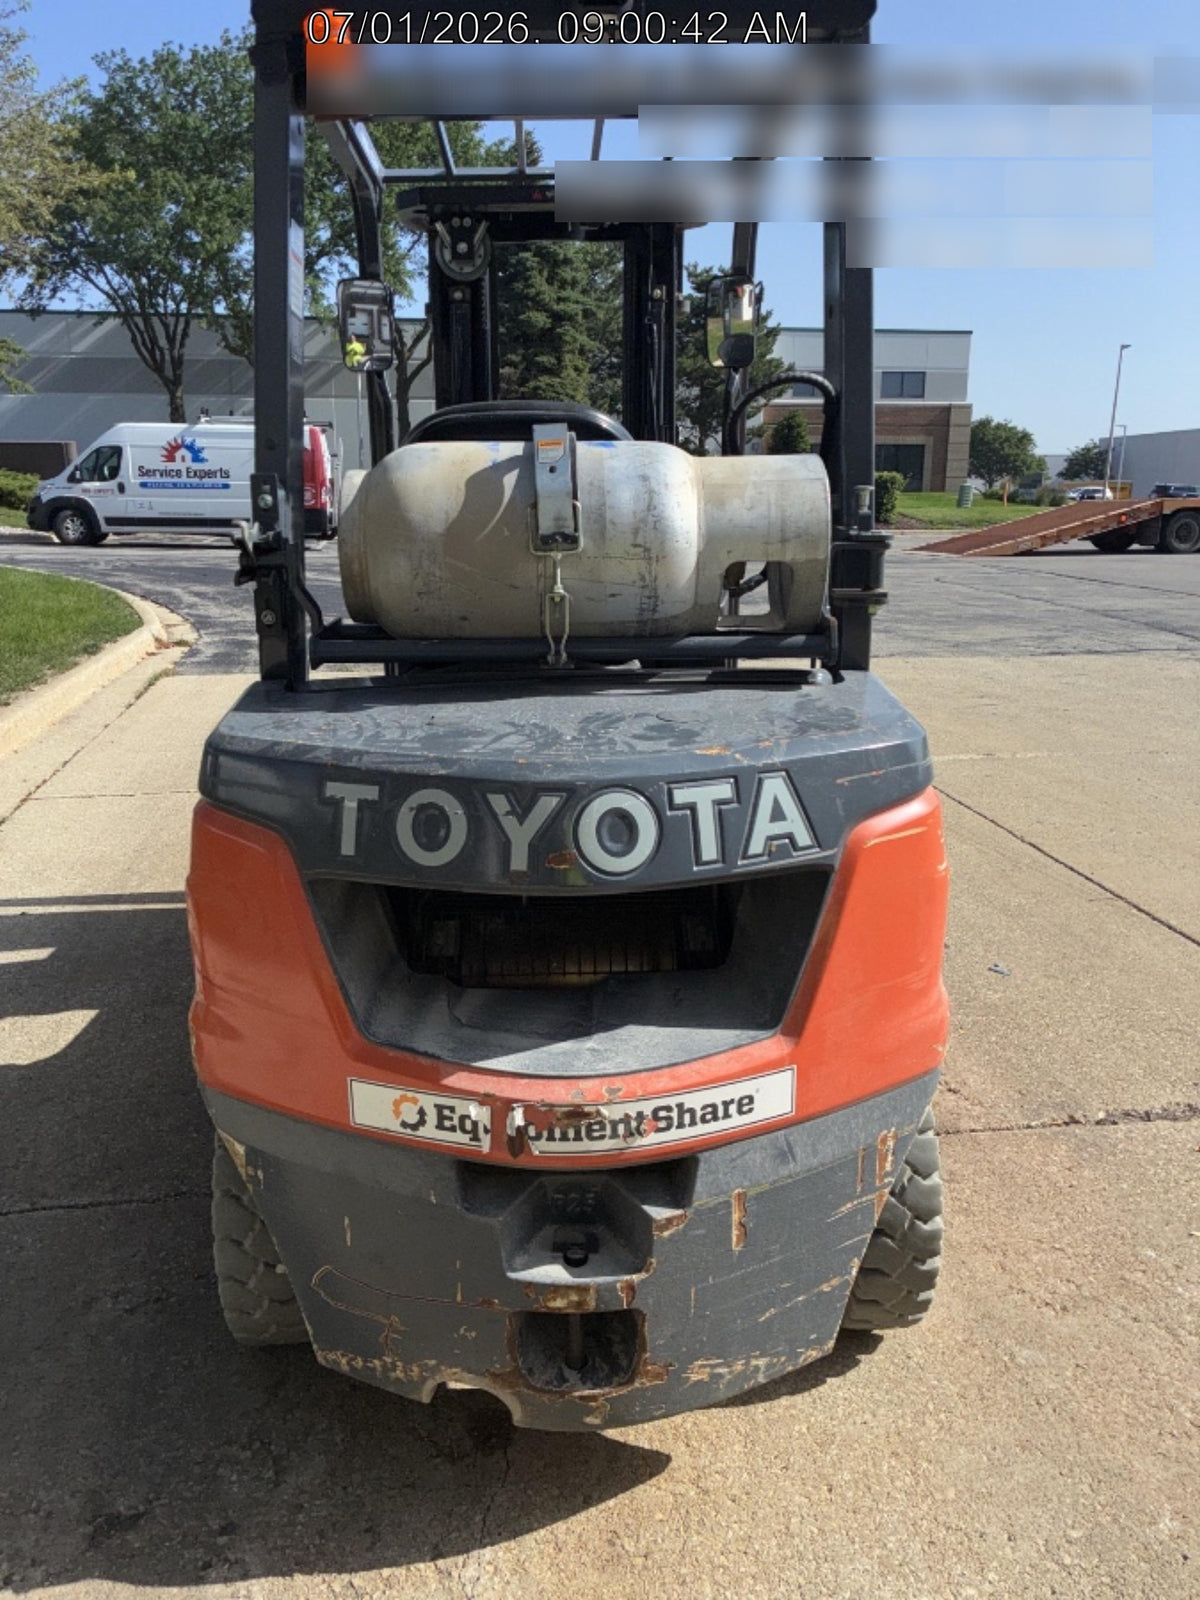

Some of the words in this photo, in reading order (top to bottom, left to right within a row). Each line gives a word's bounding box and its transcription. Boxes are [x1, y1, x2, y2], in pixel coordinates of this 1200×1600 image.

[138, 465, 182, 479] Service
[186, 467, 231, 481] Experts
[325, 771, 820, 876] TOYOTA
